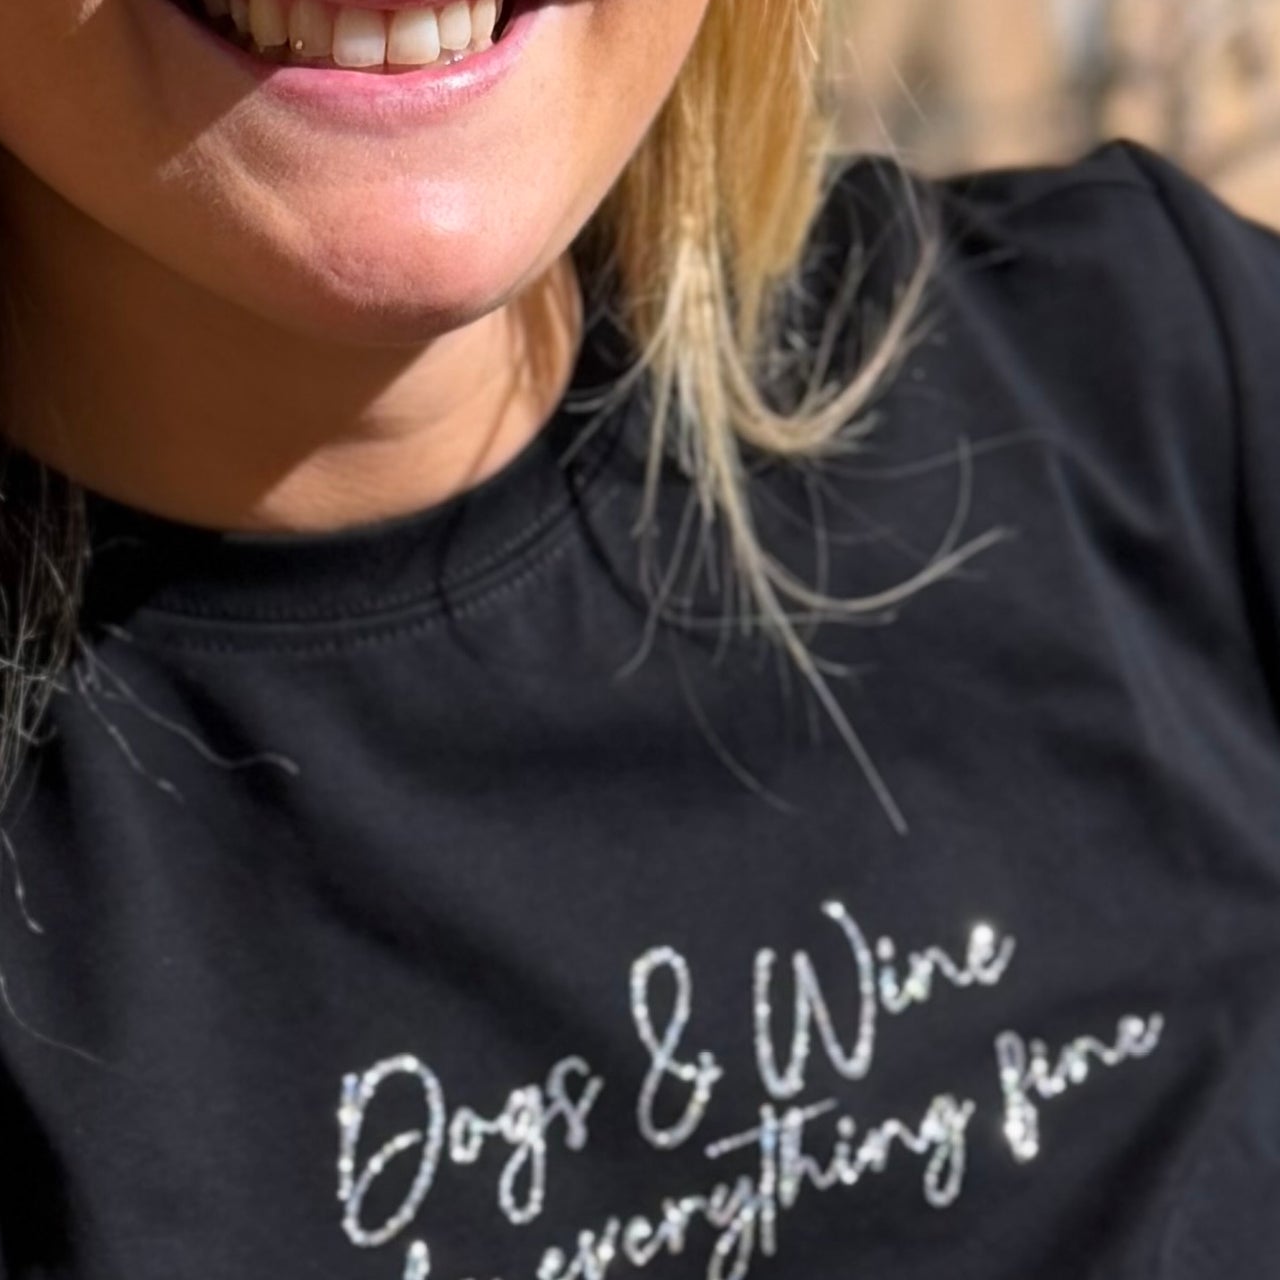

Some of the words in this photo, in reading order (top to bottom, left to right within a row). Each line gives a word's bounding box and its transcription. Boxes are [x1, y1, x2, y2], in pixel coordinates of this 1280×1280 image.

[338, 1052, 602, 1246] Dogs
[631, 946, 722, 1147] &
[753, 899, 1015, 1099] Wine
[996, 1012, 1164, 1162] fine
